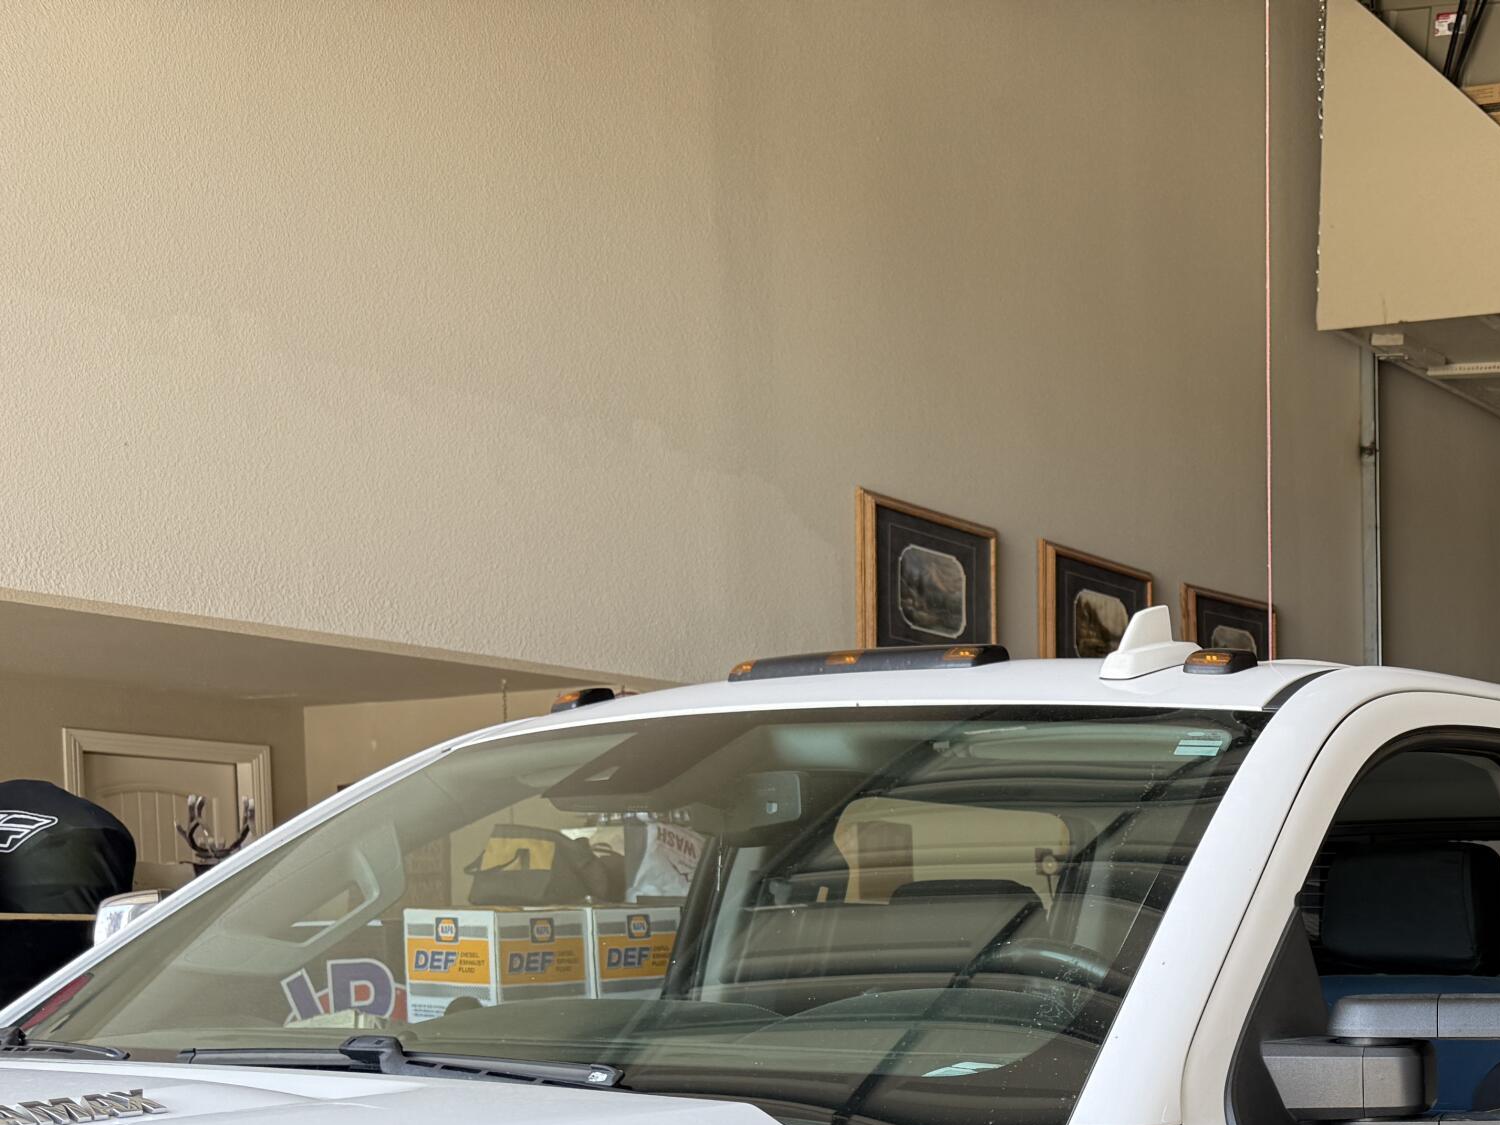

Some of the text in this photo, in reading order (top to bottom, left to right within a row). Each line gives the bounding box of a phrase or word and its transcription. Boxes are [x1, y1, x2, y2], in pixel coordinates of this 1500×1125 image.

[414, 950, 457, 971] DEF
[508, 951, 555, 973] DEF
[607, 946, 651, 968] DEF
